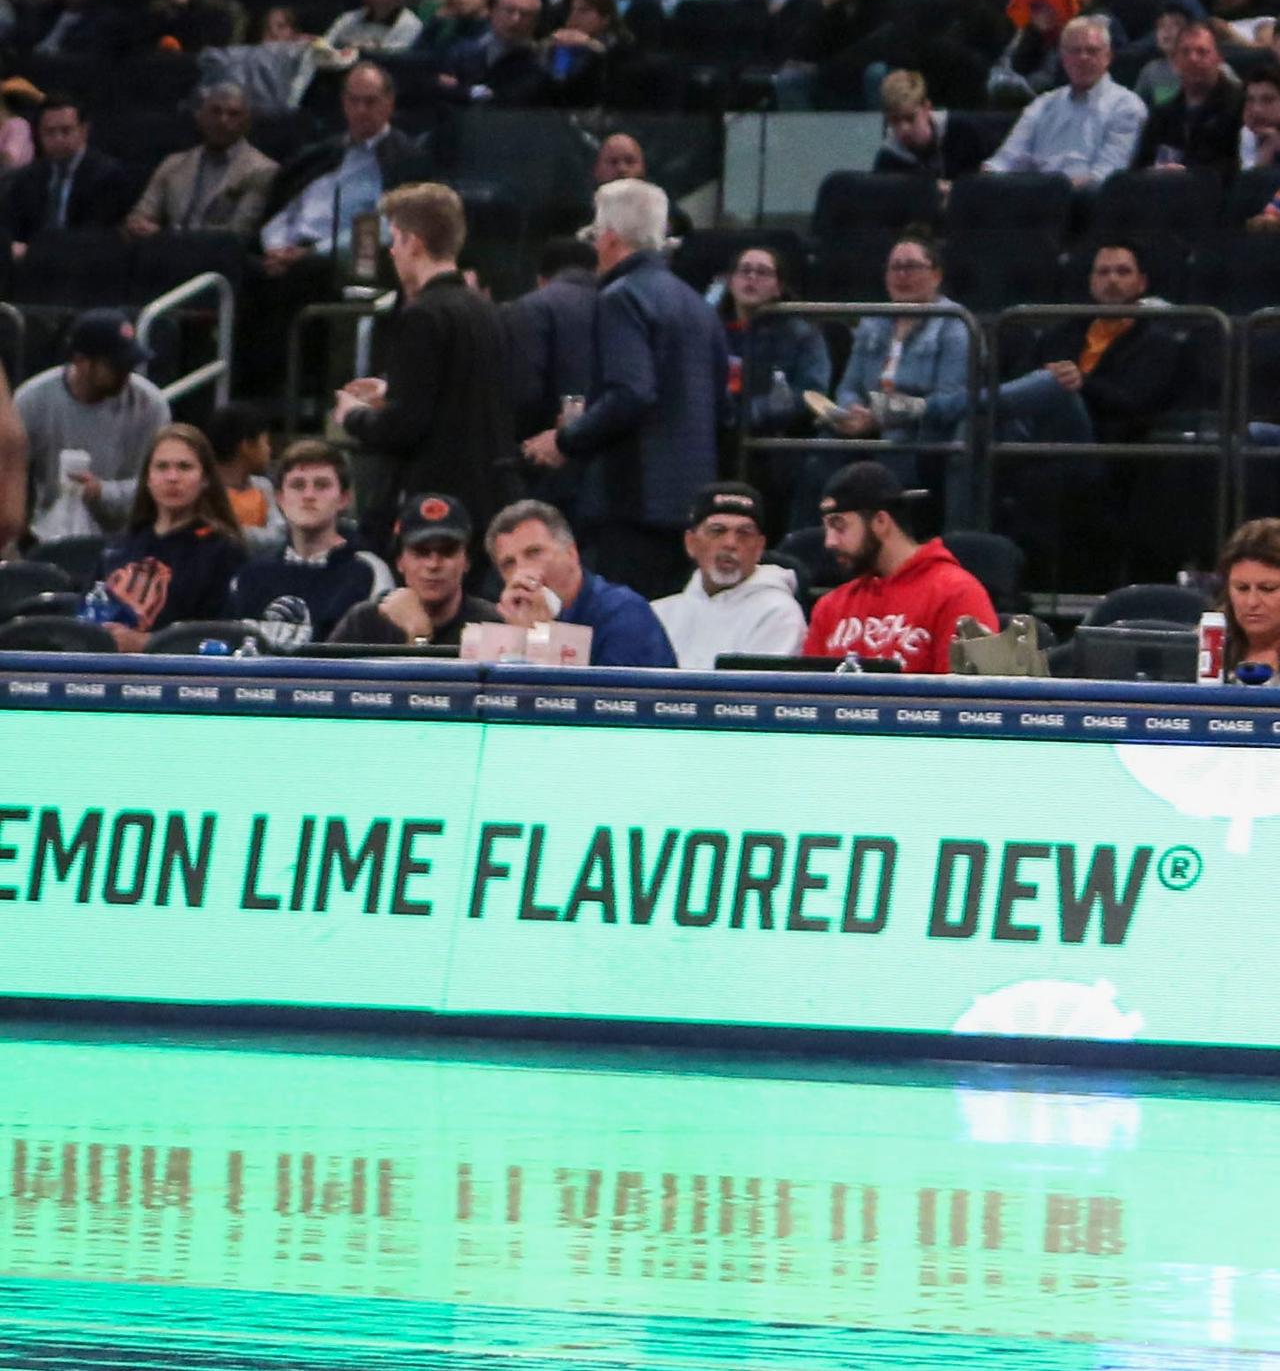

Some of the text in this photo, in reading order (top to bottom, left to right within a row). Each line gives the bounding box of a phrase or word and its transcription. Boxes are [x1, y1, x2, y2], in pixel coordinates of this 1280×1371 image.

[9, 681, 48, 694] CHASE
[65, 683, 105, 696] CHASE
[121, 685, 163, 698] CHASE
[178, 686, 219, 699] CHASE
[236, 687, 275, 700] CHASE
[293, 688, 332, 701] CHASE
[351, 691, 391, 704] CHASE
[409, 694, 449, 707] CHASE
[474, 694, 517, 707] CHASE
[535, 696, 576, 709] CHASE
[595, 699, 635, 712] CHASE
[655, 701, 695, 714] CHASE
[715, 703, 756, 716] CHASE
[775, 706, 816, 719] CHASE
[834, 707, 877, 720] CHASE
[897, 709, 939, 722] CHASE
[959, 711, 1002, 724] CHASE
[1021, 713, 1063, 726] CHASE
[1083, 715, 1126, 728] CHASE
[1146, 717, 1189, 730] CHASE
[1209, 719, 1252, 732] CHASE
[240, 813, 444, 916] LIME
[468, 822, 898, 934] FLAVORED
